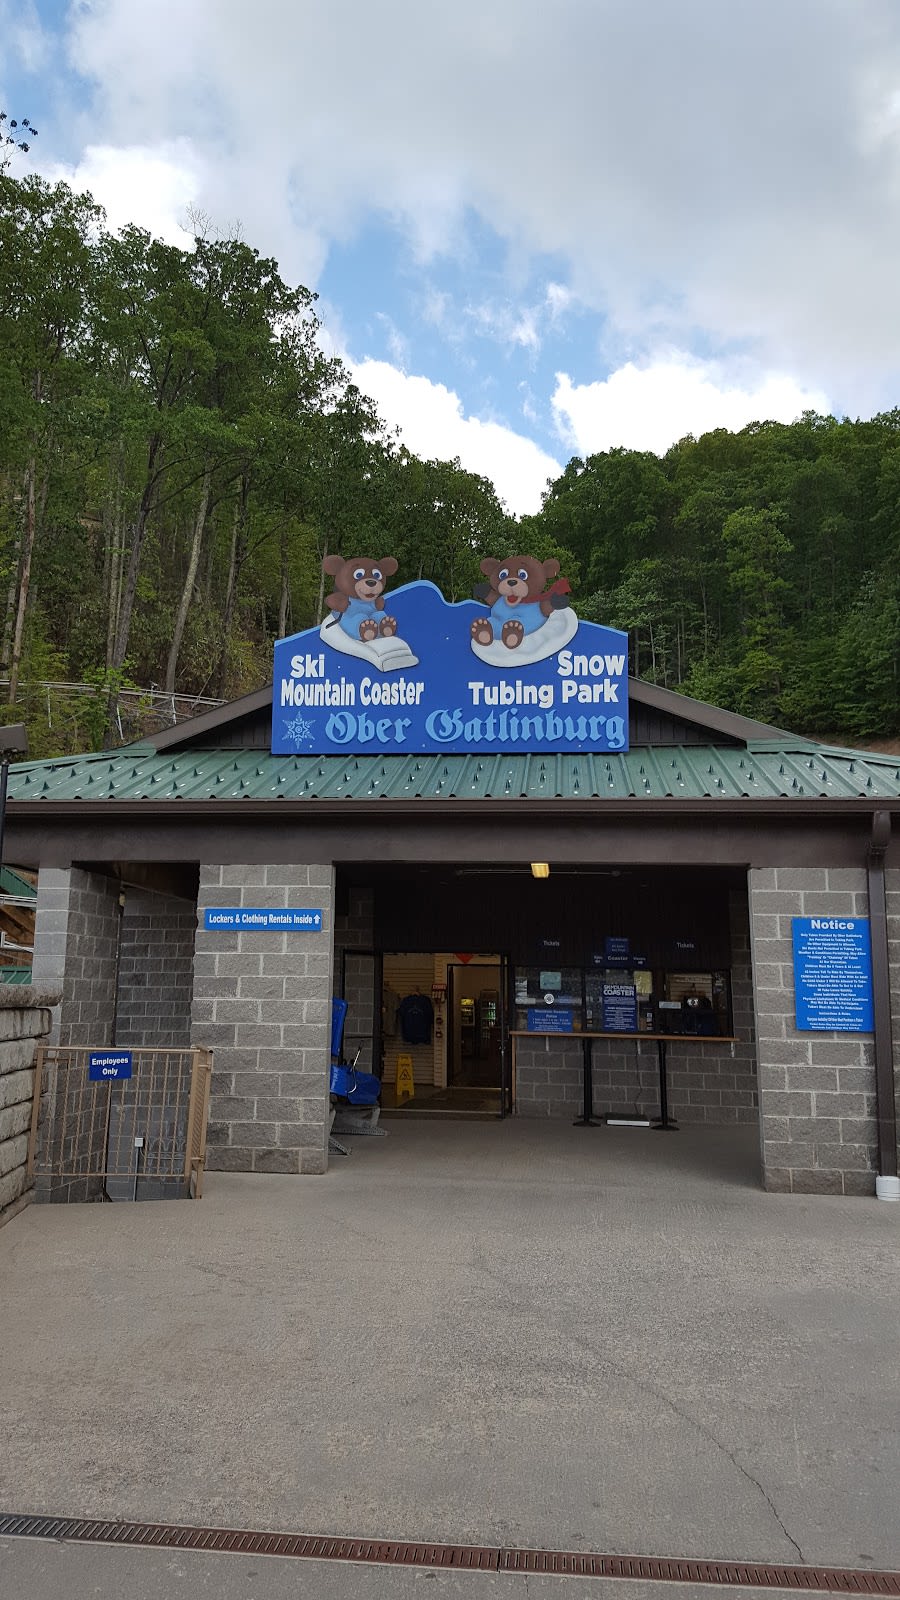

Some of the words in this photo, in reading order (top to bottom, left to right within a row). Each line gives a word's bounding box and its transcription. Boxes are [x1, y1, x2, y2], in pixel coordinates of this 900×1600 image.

[290, 654, 325, 678] Ski
[557, 650, 625, 676] Snow
[280, 677, 356, 707] Mountain
[359, 677, 425, 706] Coaster
[468, 679, 554, 708] Tubing
[562, 679, 619, 704] Park
[324, 711, 413, 745] Ober
[425, 707, 626, 749] Gatlinburg
[209, 914, 234, 924] Lockers
[235, 914, 241, 924] &
[242, 914, 267, 926] Clothing
[269, 914, 292, 924] Rentals
[294, 915, 313, 924] Inside
[810, 919, 855, 930] Notice
[676, 941, 695, 949] Tickets
[603, 989, 635, 997] COASTER
[91, 1057, 129, 1066] Employees
[102, 1067, 118, 1077] Only
